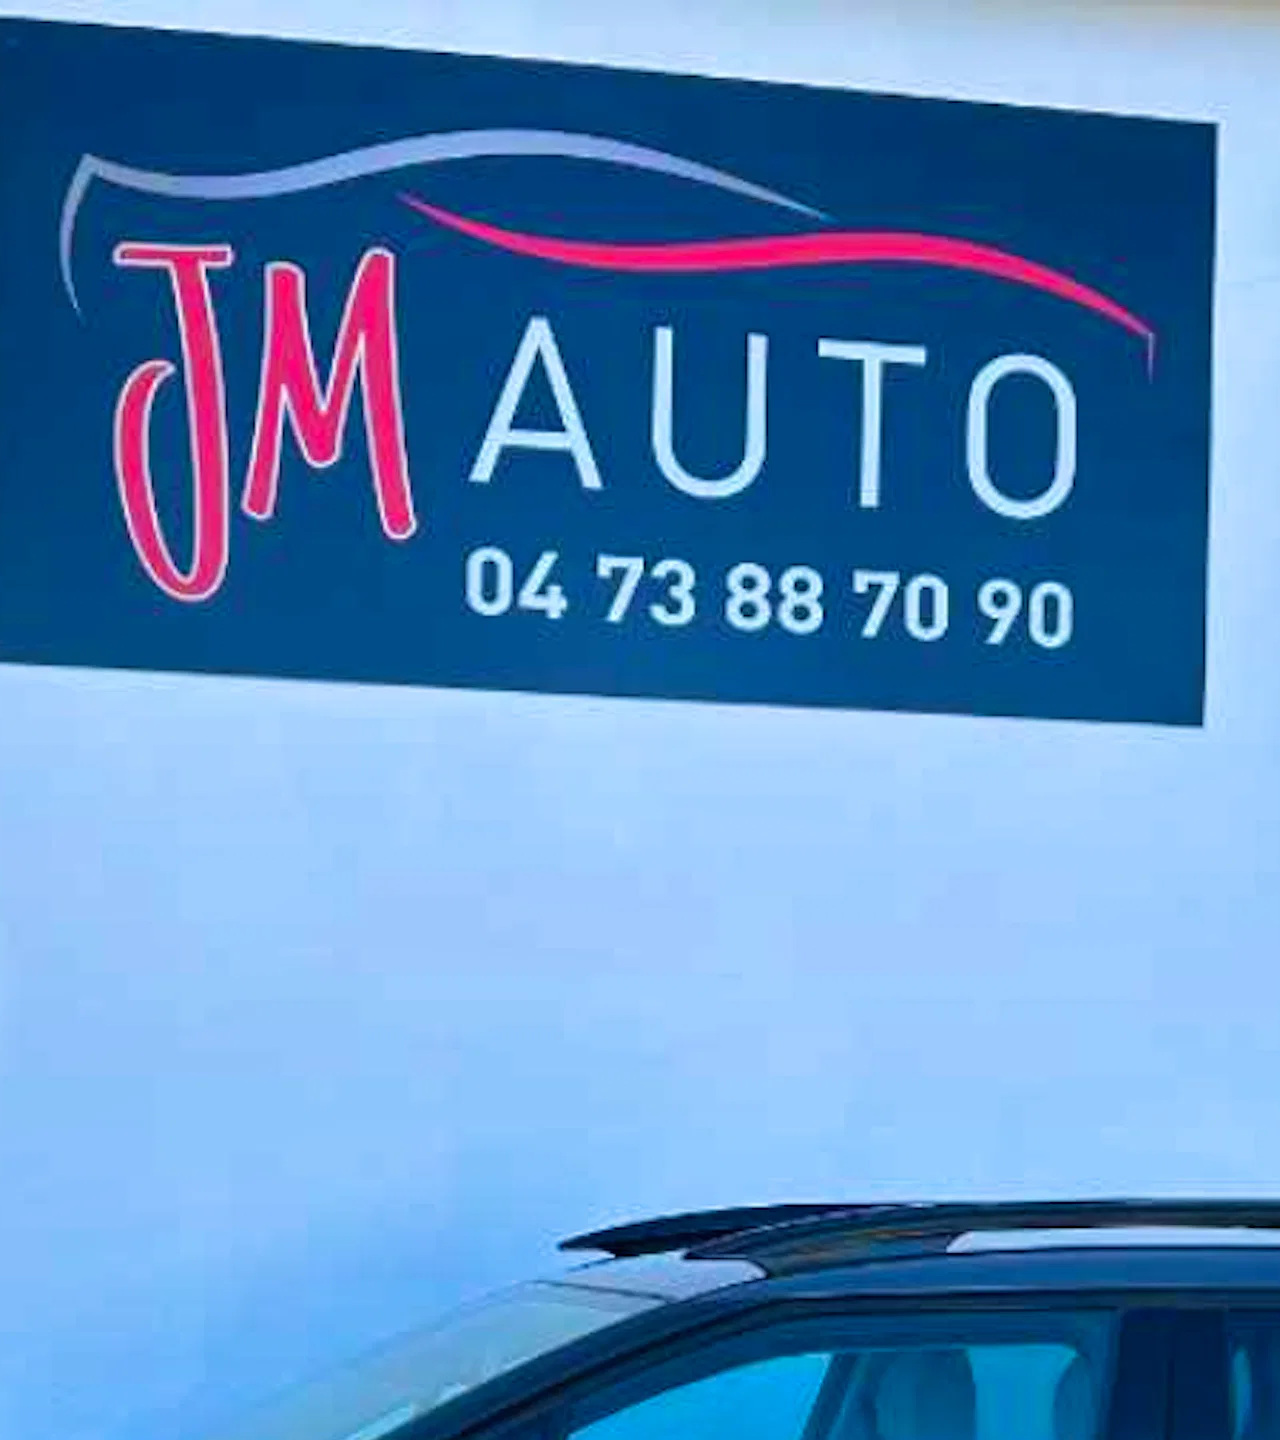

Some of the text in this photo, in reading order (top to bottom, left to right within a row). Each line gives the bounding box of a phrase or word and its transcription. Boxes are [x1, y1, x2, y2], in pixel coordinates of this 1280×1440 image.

[112, 241, 1079, 604] JM AUTO
[466, 547, 1075, 651] 04 73 88 70 90
